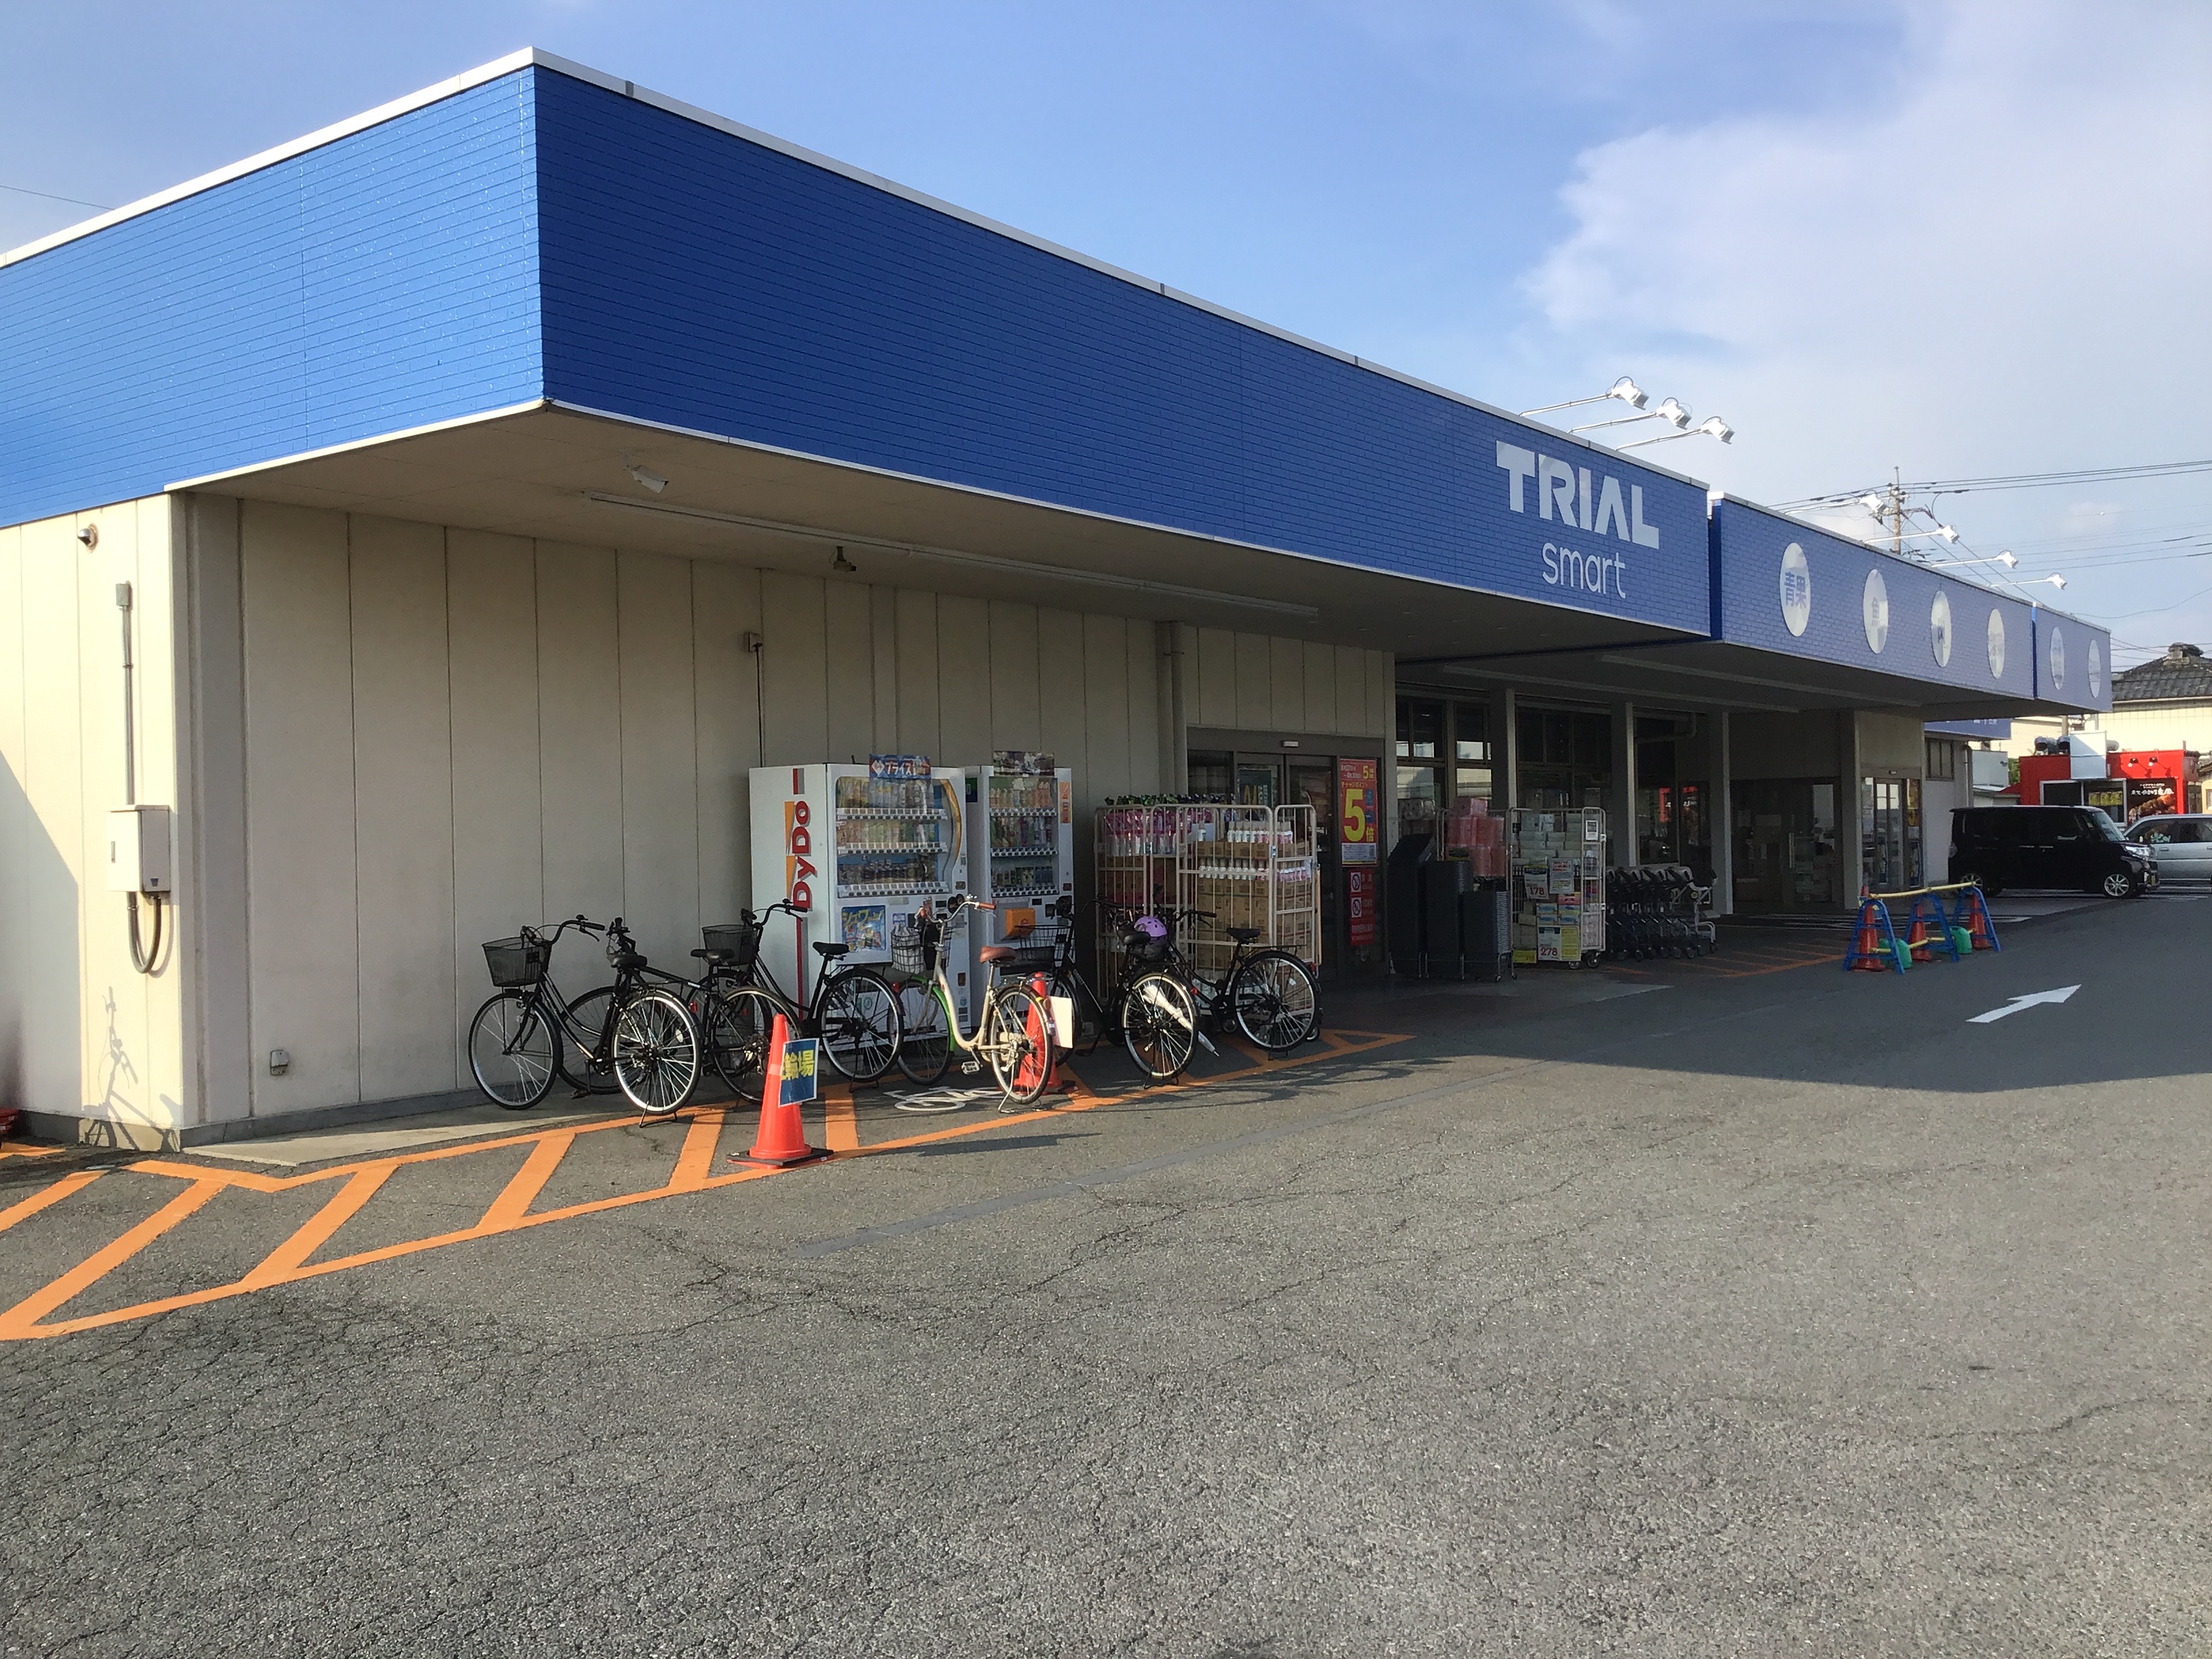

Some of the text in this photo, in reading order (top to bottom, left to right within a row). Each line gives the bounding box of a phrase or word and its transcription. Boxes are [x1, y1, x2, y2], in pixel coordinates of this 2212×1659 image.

[1496, 440, 1659, 550] TRIAL
[1542, 542, 1626, 598] smart
[1784, 571, 1807, 609] 青果
[1530, 886, 1544, 895] 178
[1540, 947, 1558, 956] 278
[781, 1049, 815, 1080] 輪場
